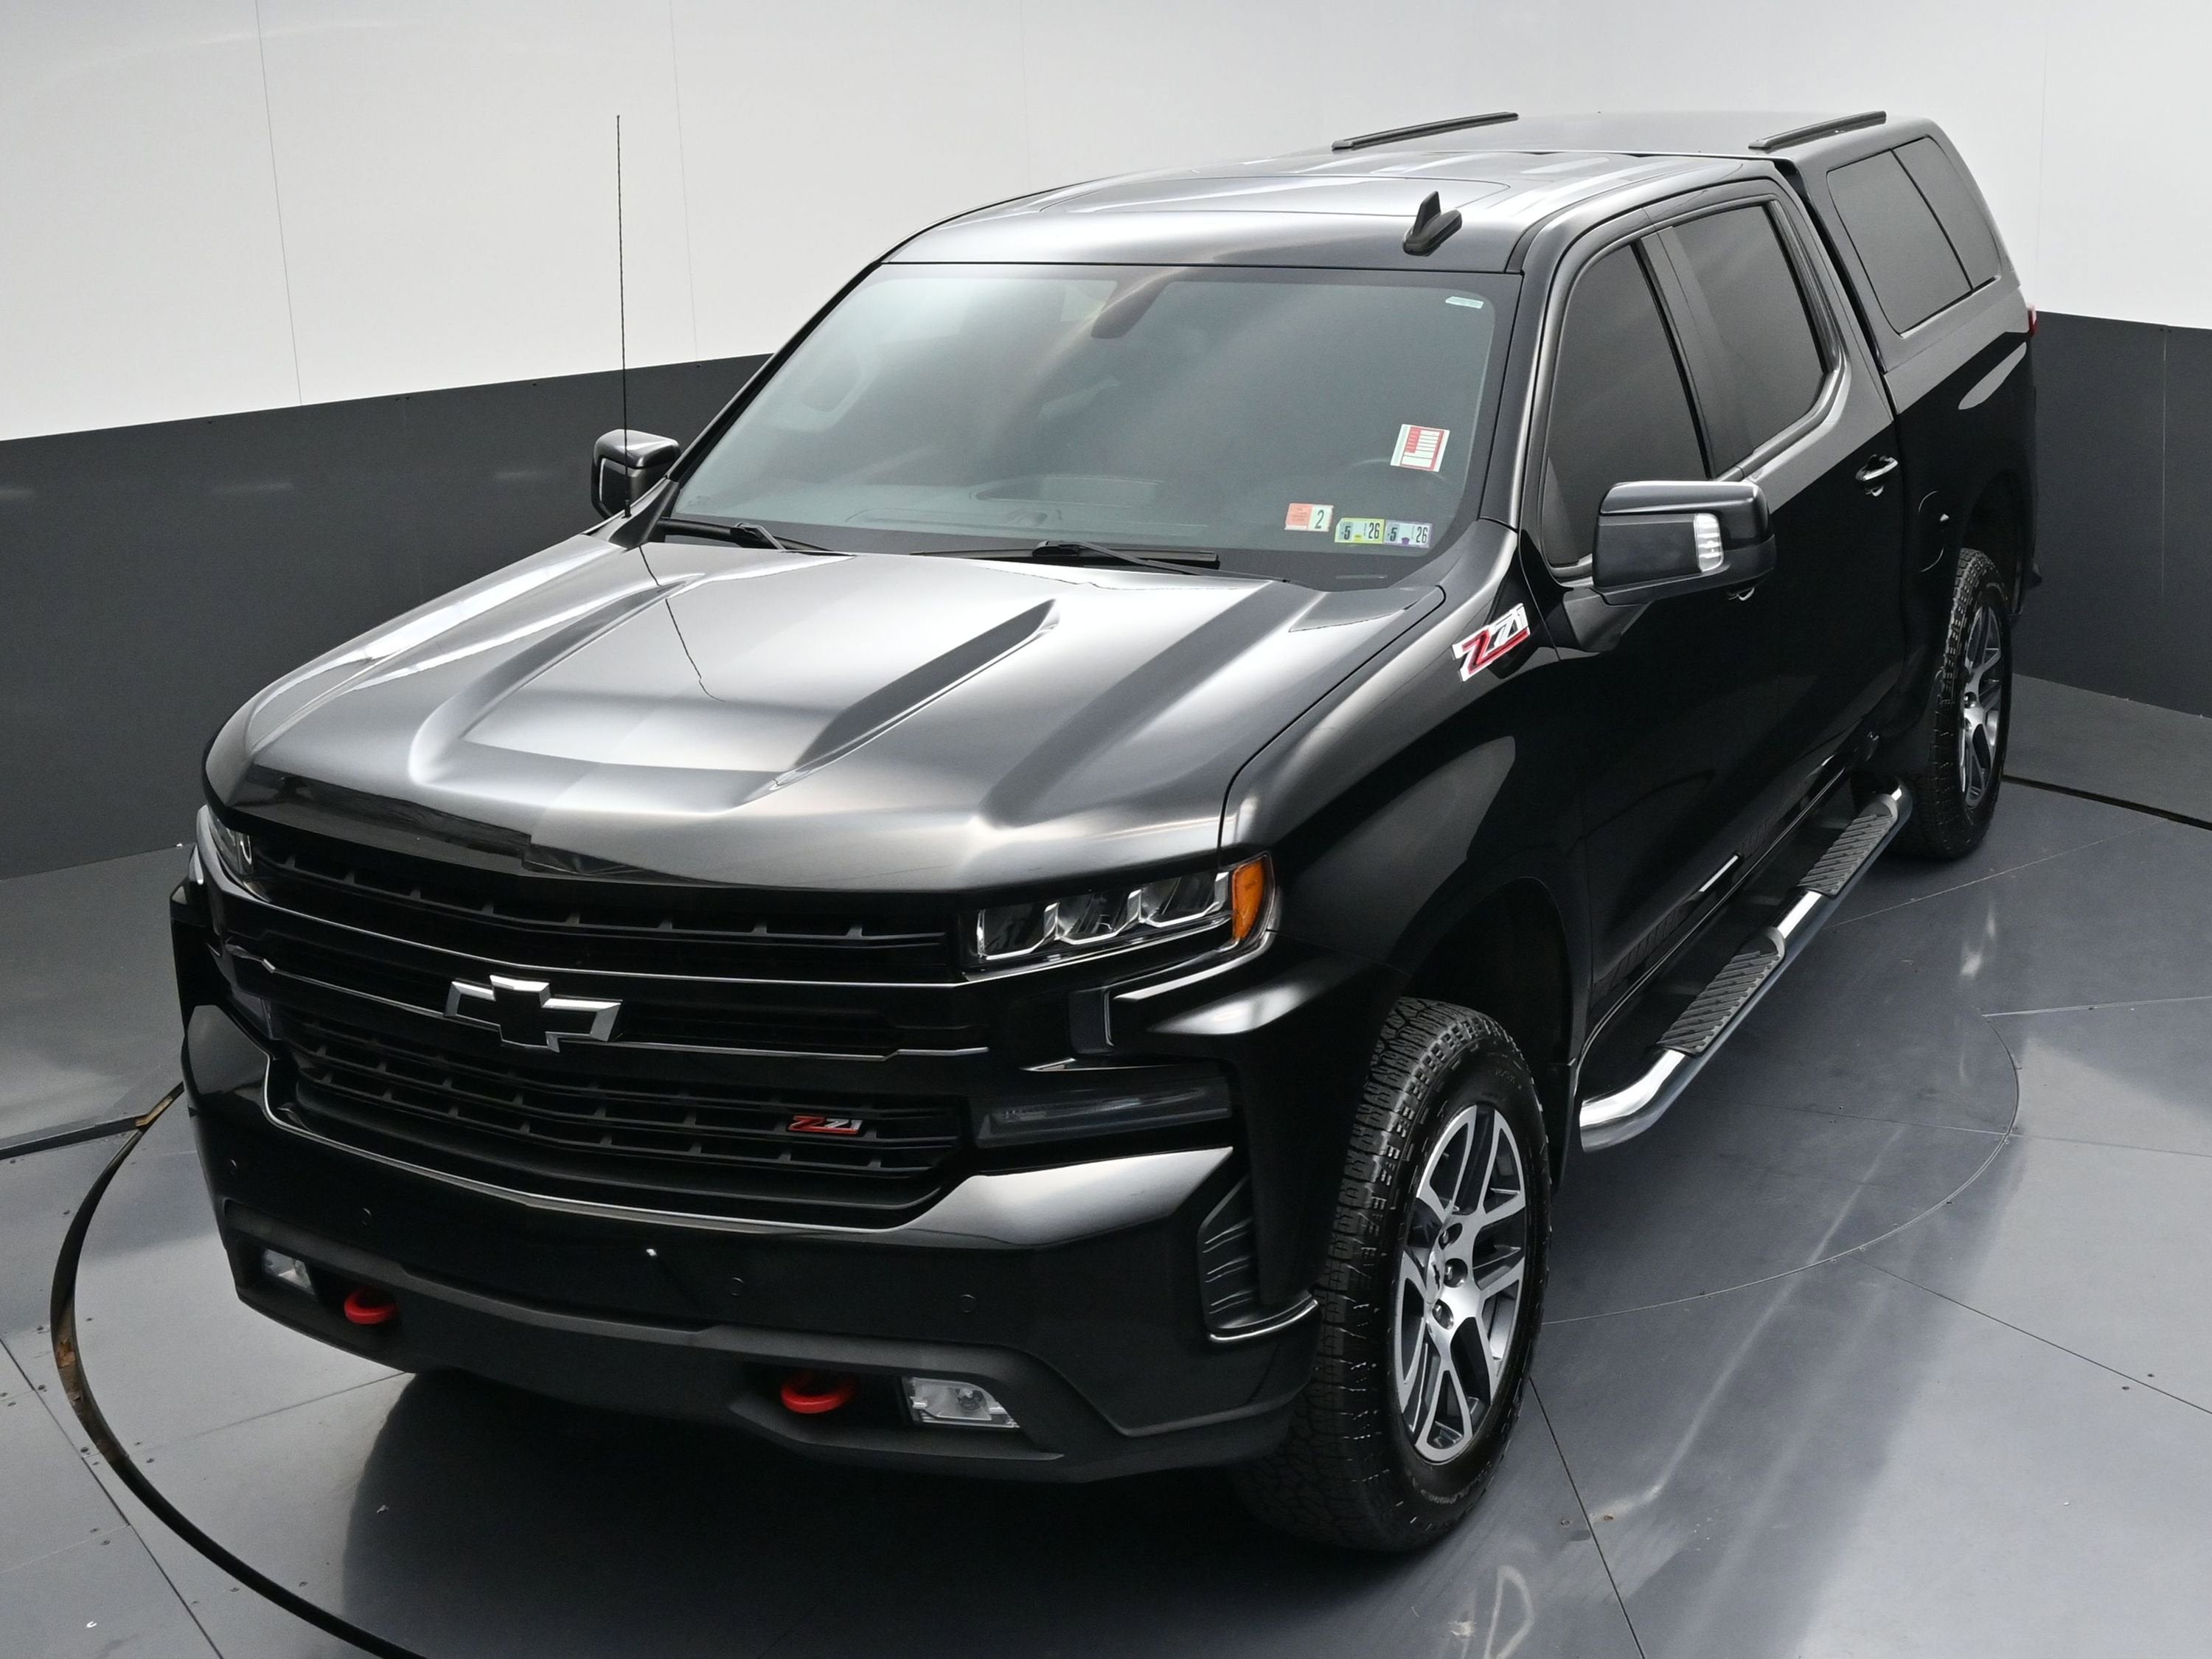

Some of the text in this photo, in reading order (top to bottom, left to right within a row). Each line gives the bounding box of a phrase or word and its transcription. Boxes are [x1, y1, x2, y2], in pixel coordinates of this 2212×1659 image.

[1314, 509, 1324, 529] 2
[1368, 522, 1380, 539] 26
[1416, 526, 1428, 543] 26
[1452, 603, 1530, 682] Z71
[788, 1115, 863, 1135] Z71
